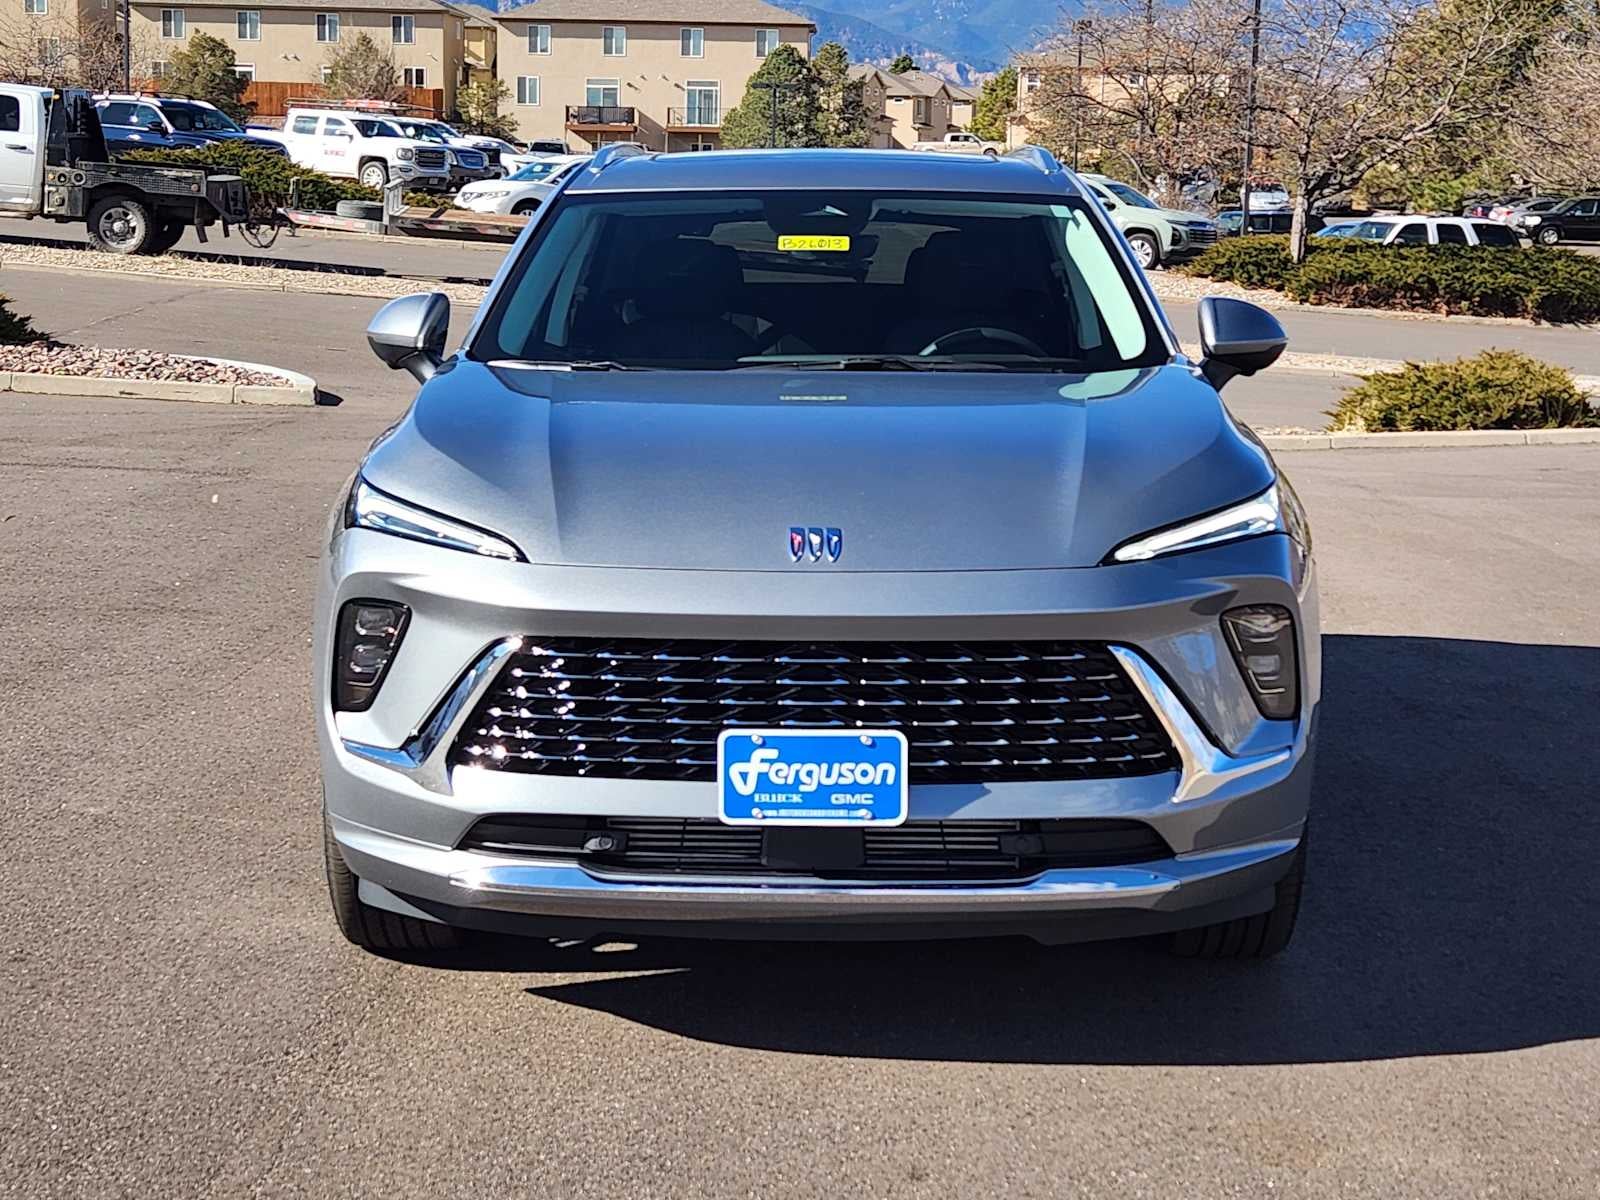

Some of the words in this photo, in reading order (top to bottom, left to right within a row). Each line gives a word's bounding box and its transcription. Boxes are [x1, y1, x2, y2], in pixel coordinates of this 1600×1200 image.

[729, 748, 896, 796] Ferguson
[754, 793, 803, 803] BUICK
[830, 793, 874, 805] GMC
